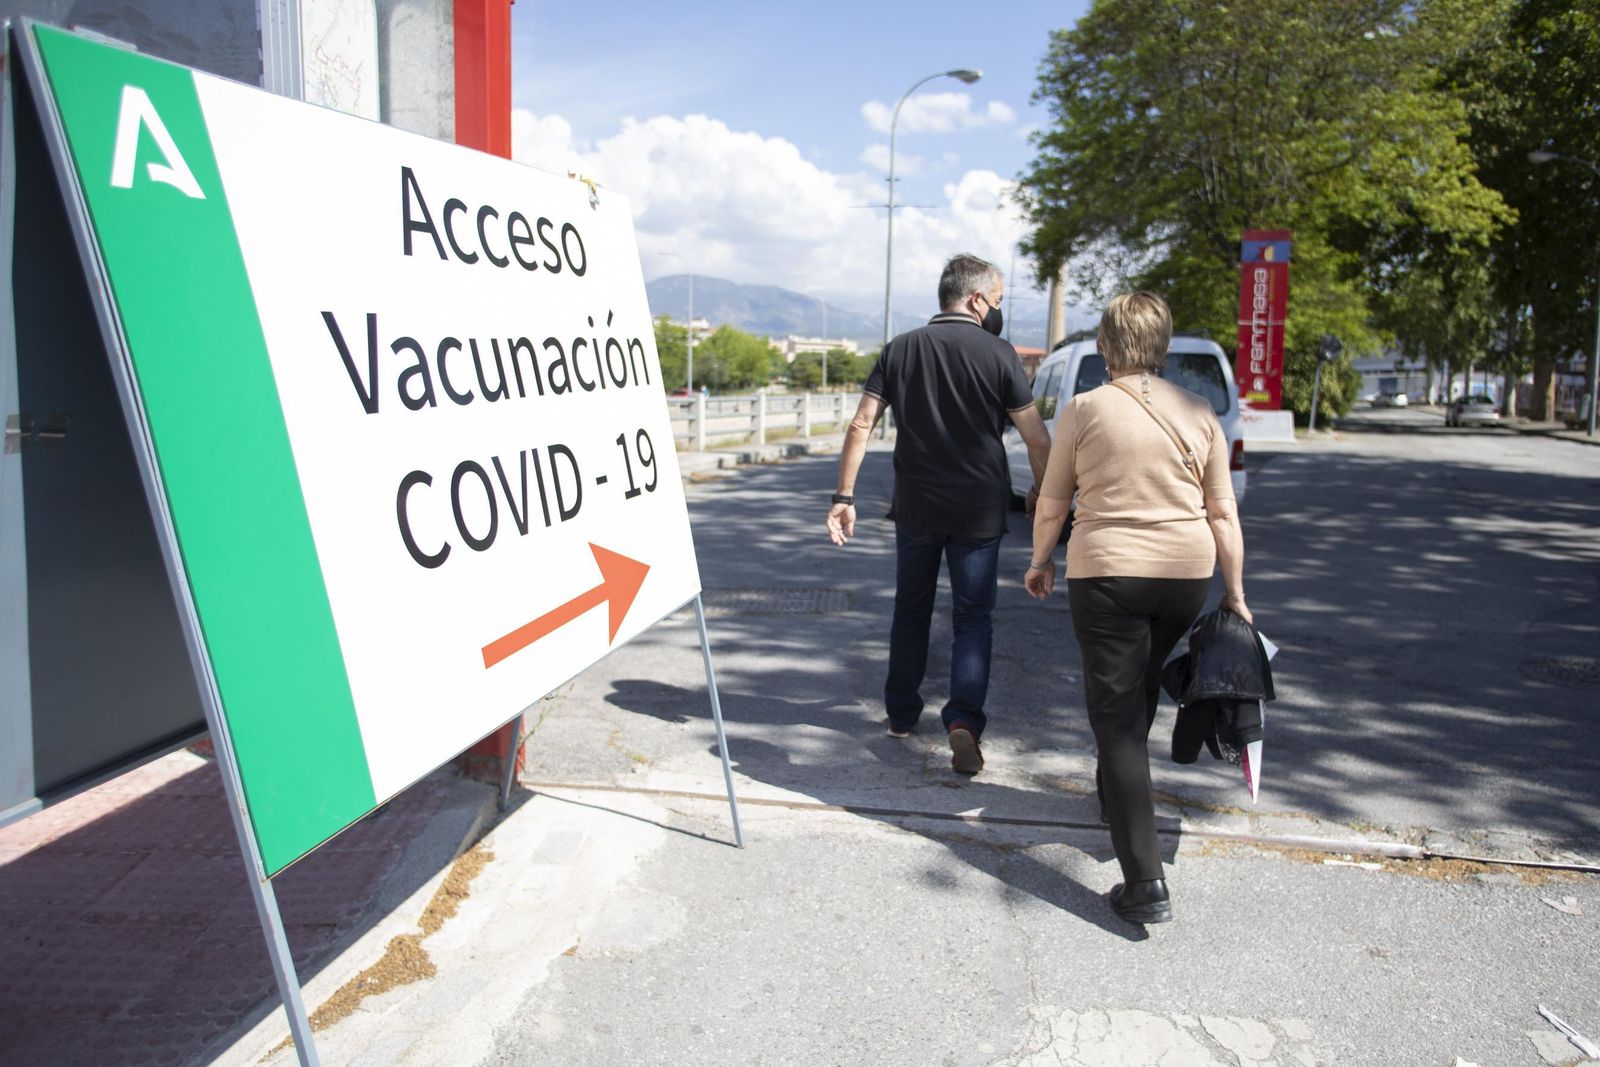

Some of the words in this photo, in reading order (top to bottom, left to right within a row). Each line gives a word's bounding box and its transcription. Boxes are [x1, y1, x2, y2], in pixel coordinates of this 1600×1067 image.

[402, 166, 588, 277] Acceso
[321, 310, 650, 415] Vacunación
[396, 443, 583, 569] COVID
